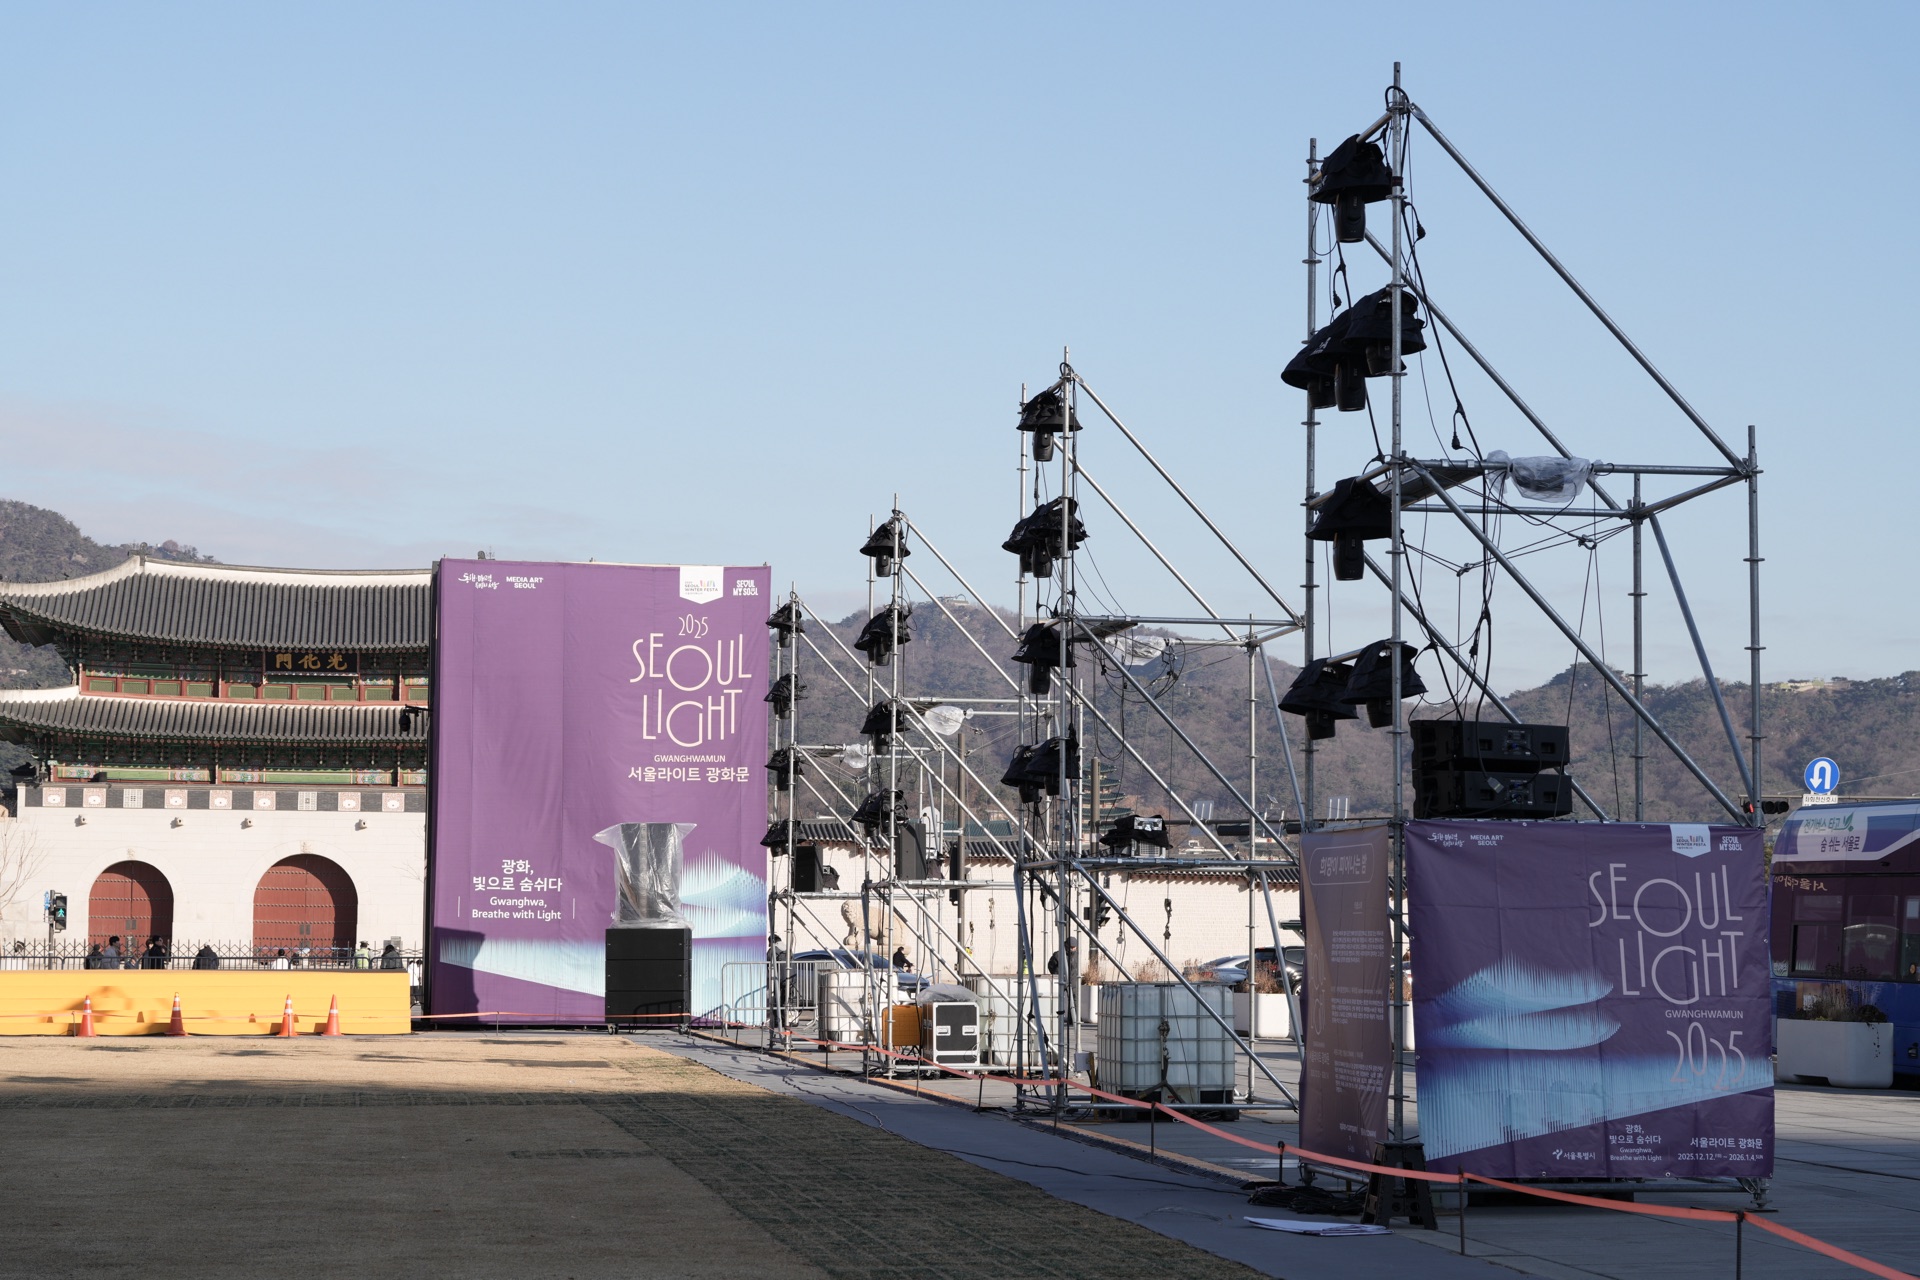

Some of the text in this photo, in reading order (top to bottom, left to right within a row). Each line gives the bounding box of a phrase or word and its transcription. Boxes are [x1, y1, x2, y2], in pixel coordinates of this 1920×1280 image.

[736, 579, 755, 588] SEOUL
[732, 588, 759, 596] MY SOUL
[678, 613, 709, 639] 2025
[630, 633, 752, 692] SEOUL
[643, 688, 743, 748] LIGHT
[654, 754, 726, 763] GWANGHWAMUN
[628, 766, 750, 783] 서울라이트 광화문
[1820, 835, 1860, 853] 숨 쉬는 서울로
[501, 859, 534, 876] 광화,
[1319, 853, 1368, 877] 희망이 피어나는 밤
[472, 876, 563, 892] 빛으로 숨쉬다
[489, 896, 547, 909] Gwanghwa,
[1589, 863, 1743, 937] SEOUL
[472, 909, 562, 922] Breathe with Light
[1619, 930, 1744, 1005] LIGHT
[1665, 1009, 1744, 1019] GWANGHWAMUN
[1667, 1021, 1746, 1091] 2025
[1625, 1124, 1645, 1134] 광화,
[1609, 1135, 1662, 1145] 빛으로 숨쉬다
[1690, 1137, 1763, 1150] 서울라이트 광화문
[1563, 1152, 1596, 1160] 서울특별시
[1620, 1147, 1654, 1155] Gwanghwa,
[1647, 1155, 1662, 1163] Light
